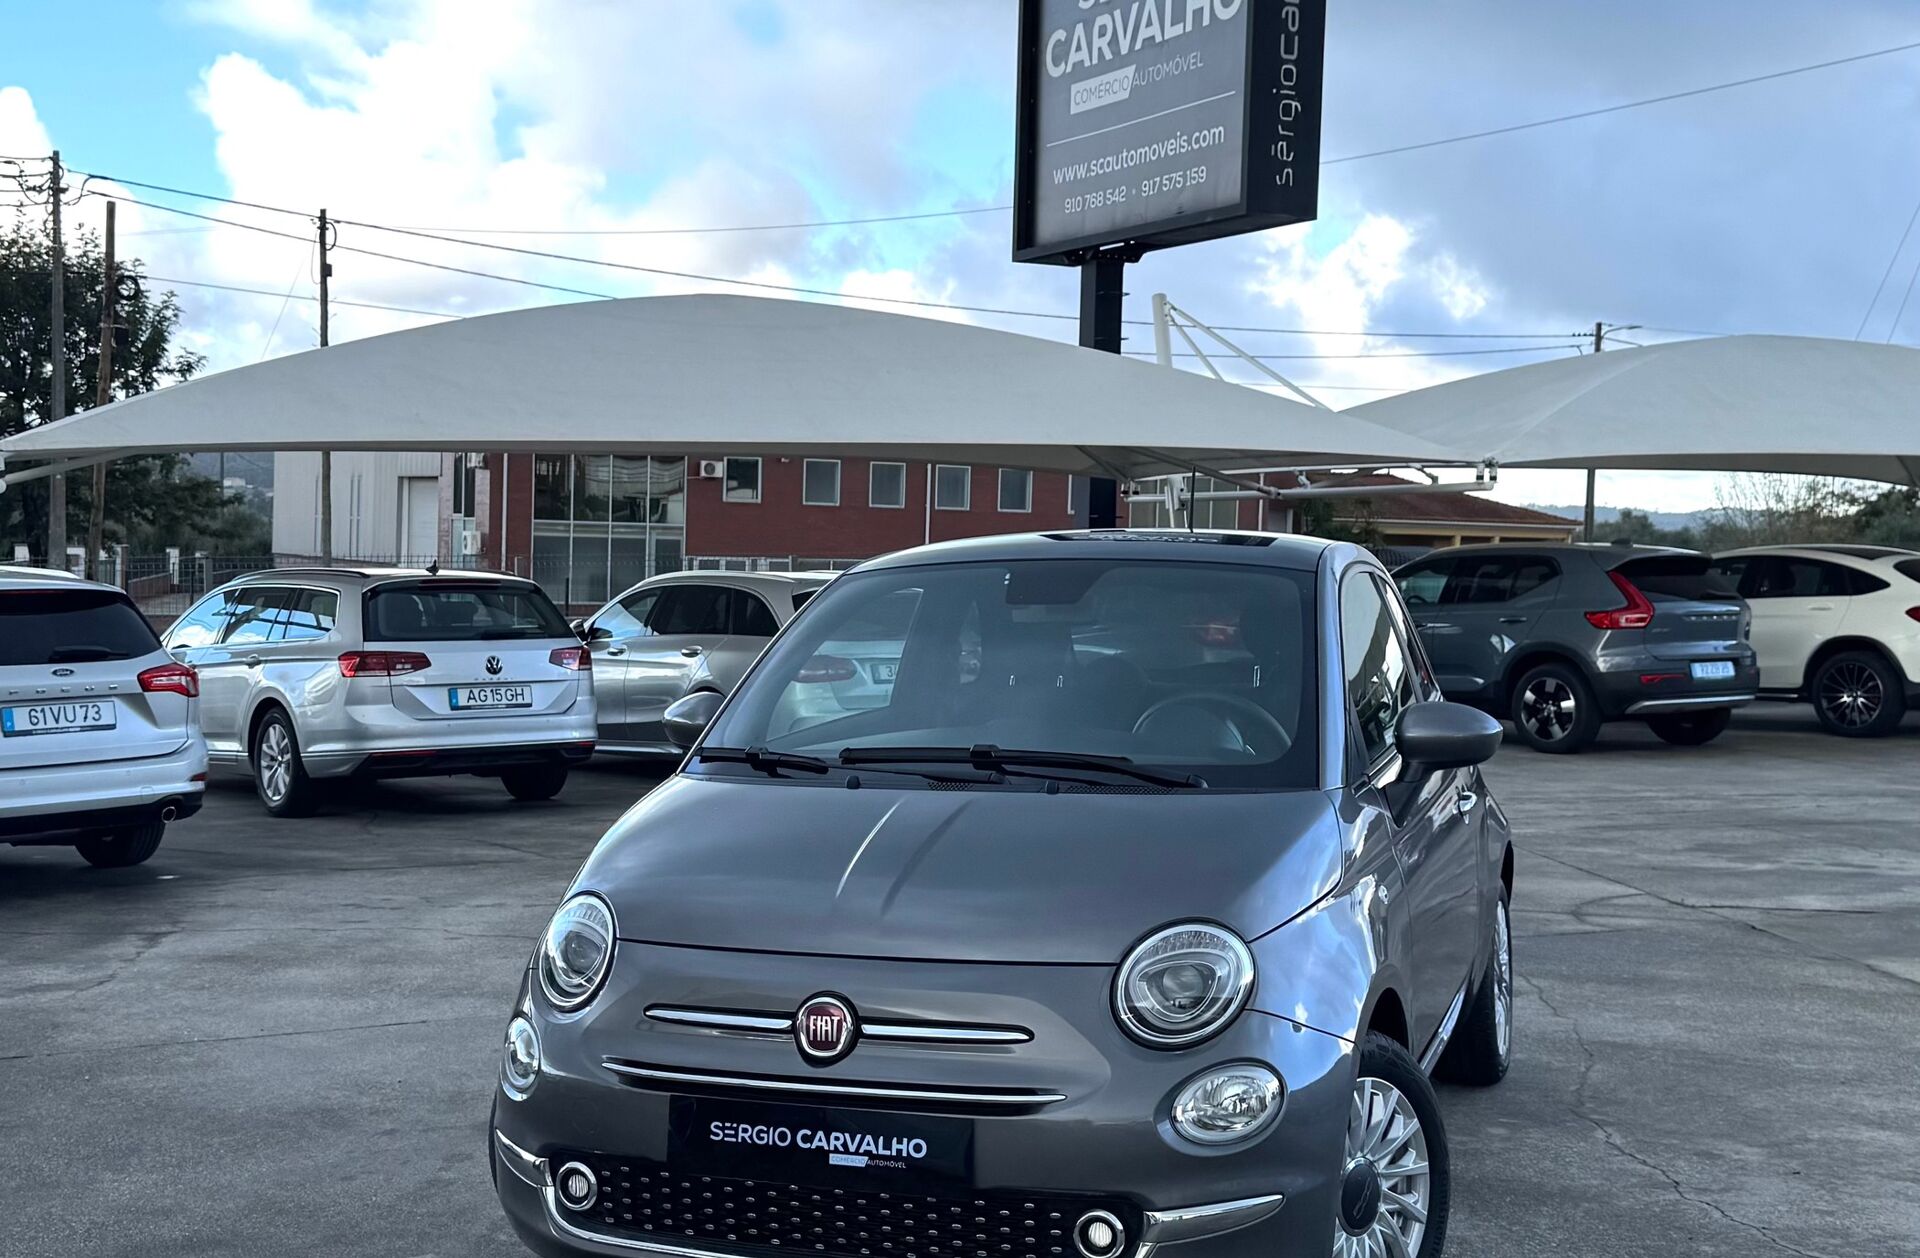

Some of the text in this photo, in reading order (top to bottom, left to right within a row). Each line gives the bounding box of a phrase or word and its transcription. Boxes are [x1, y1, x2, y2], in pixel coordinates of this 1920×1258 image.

[1073, 52, 1204, 106] COMÉRCIO AUTOMÓVEL
[1053, 125, 1225, 184] www.scautomoveis.com
[1064, 165, 1207, 213] 910 768 542 917 575 159
[809, 1015, 841, 1042] FIAT
[796, 1129, 928, 1158] CARVALHO
